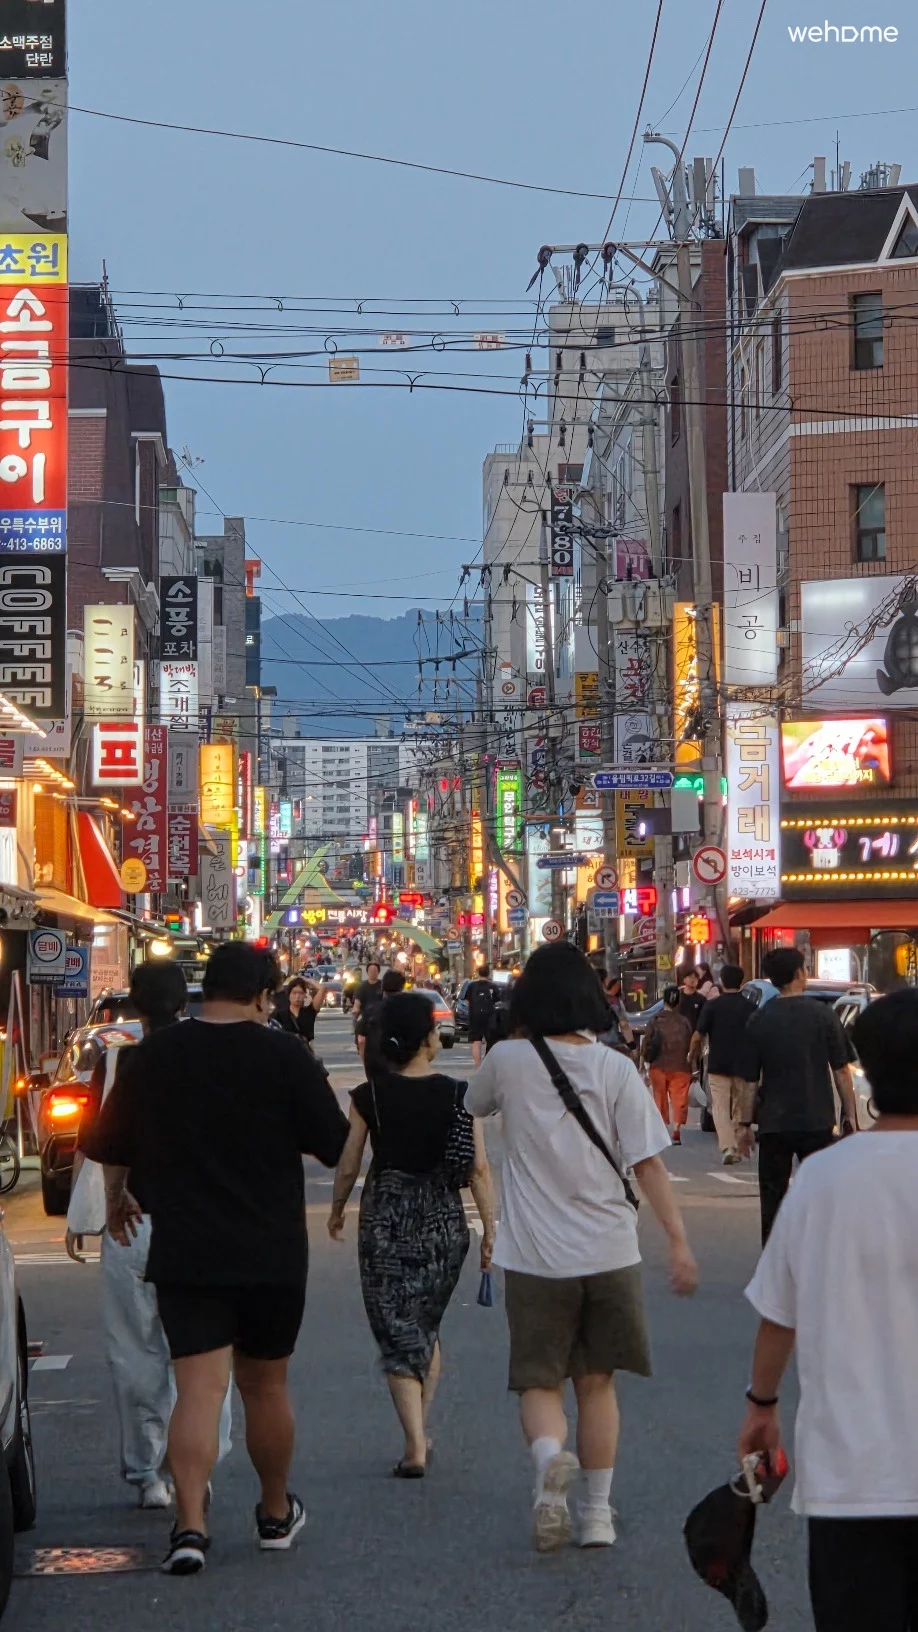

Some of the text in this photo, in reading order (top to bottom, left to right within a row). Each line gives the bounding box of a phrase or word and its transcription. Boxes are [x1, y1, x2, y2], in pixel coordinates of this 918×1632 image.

[0, 36, 53, 50] 소맥주점
[26, 53, 53, 67] 단란
[0, 242, 60, 277] 초원
[0, 288, 53, 504] 소금구이
[165, 580, 195, 637] 소풍
[0, 565, 52, 707] COFFEE
[163, 641, 195, 657] 포차
[612, 774, 655, 784] 올림픽로32길
[734, 726, 772, 842] 금거래
[731, 848, 775, 861] 보석시계
[731, 864, 776, 878] 방이보석
[731, 887, 776, 896] 423-7775
[301, 908, 326, 925] 방이
[546, 926, 558, 936] 30
[38, 941, 58, 953] 담배
